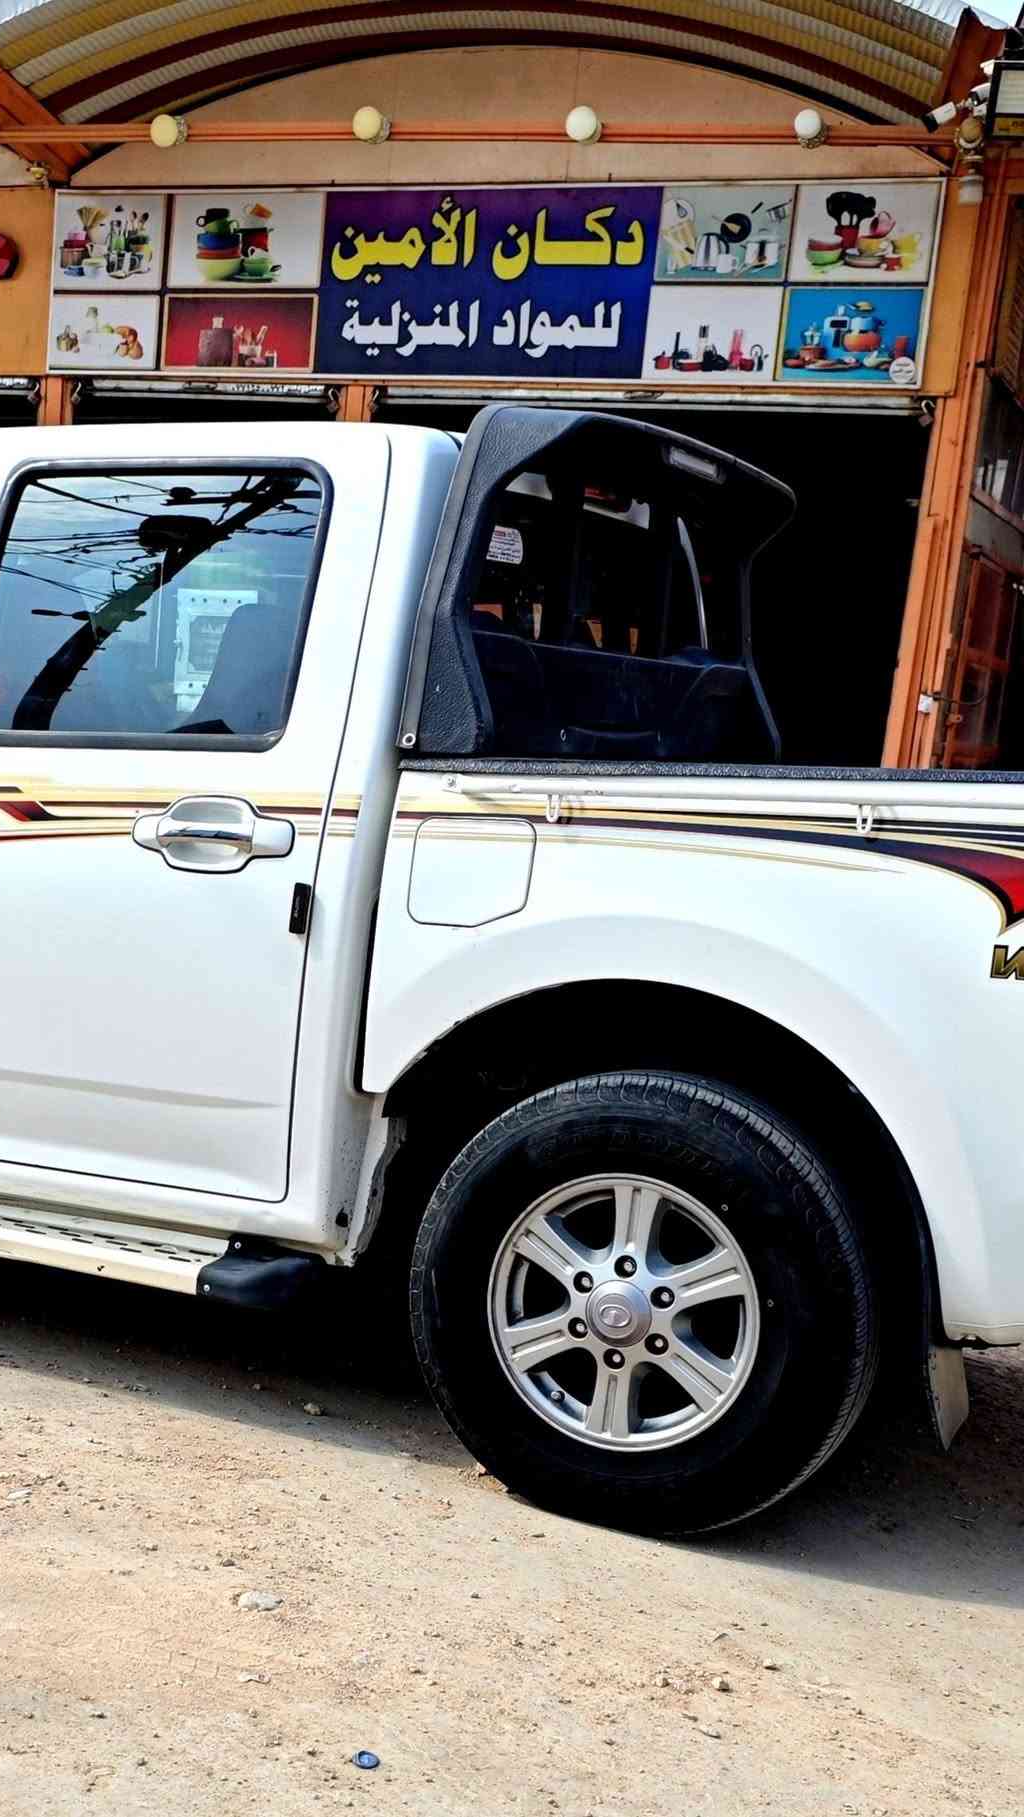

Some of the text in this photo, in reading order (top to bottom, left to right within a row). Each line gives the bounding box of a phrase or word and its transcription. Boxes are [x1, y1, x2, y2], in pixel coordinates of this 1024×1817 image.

[331, 196, 644, 284] دكان الأمين
[341, 299, 622, 358] للمواد المنزلية
